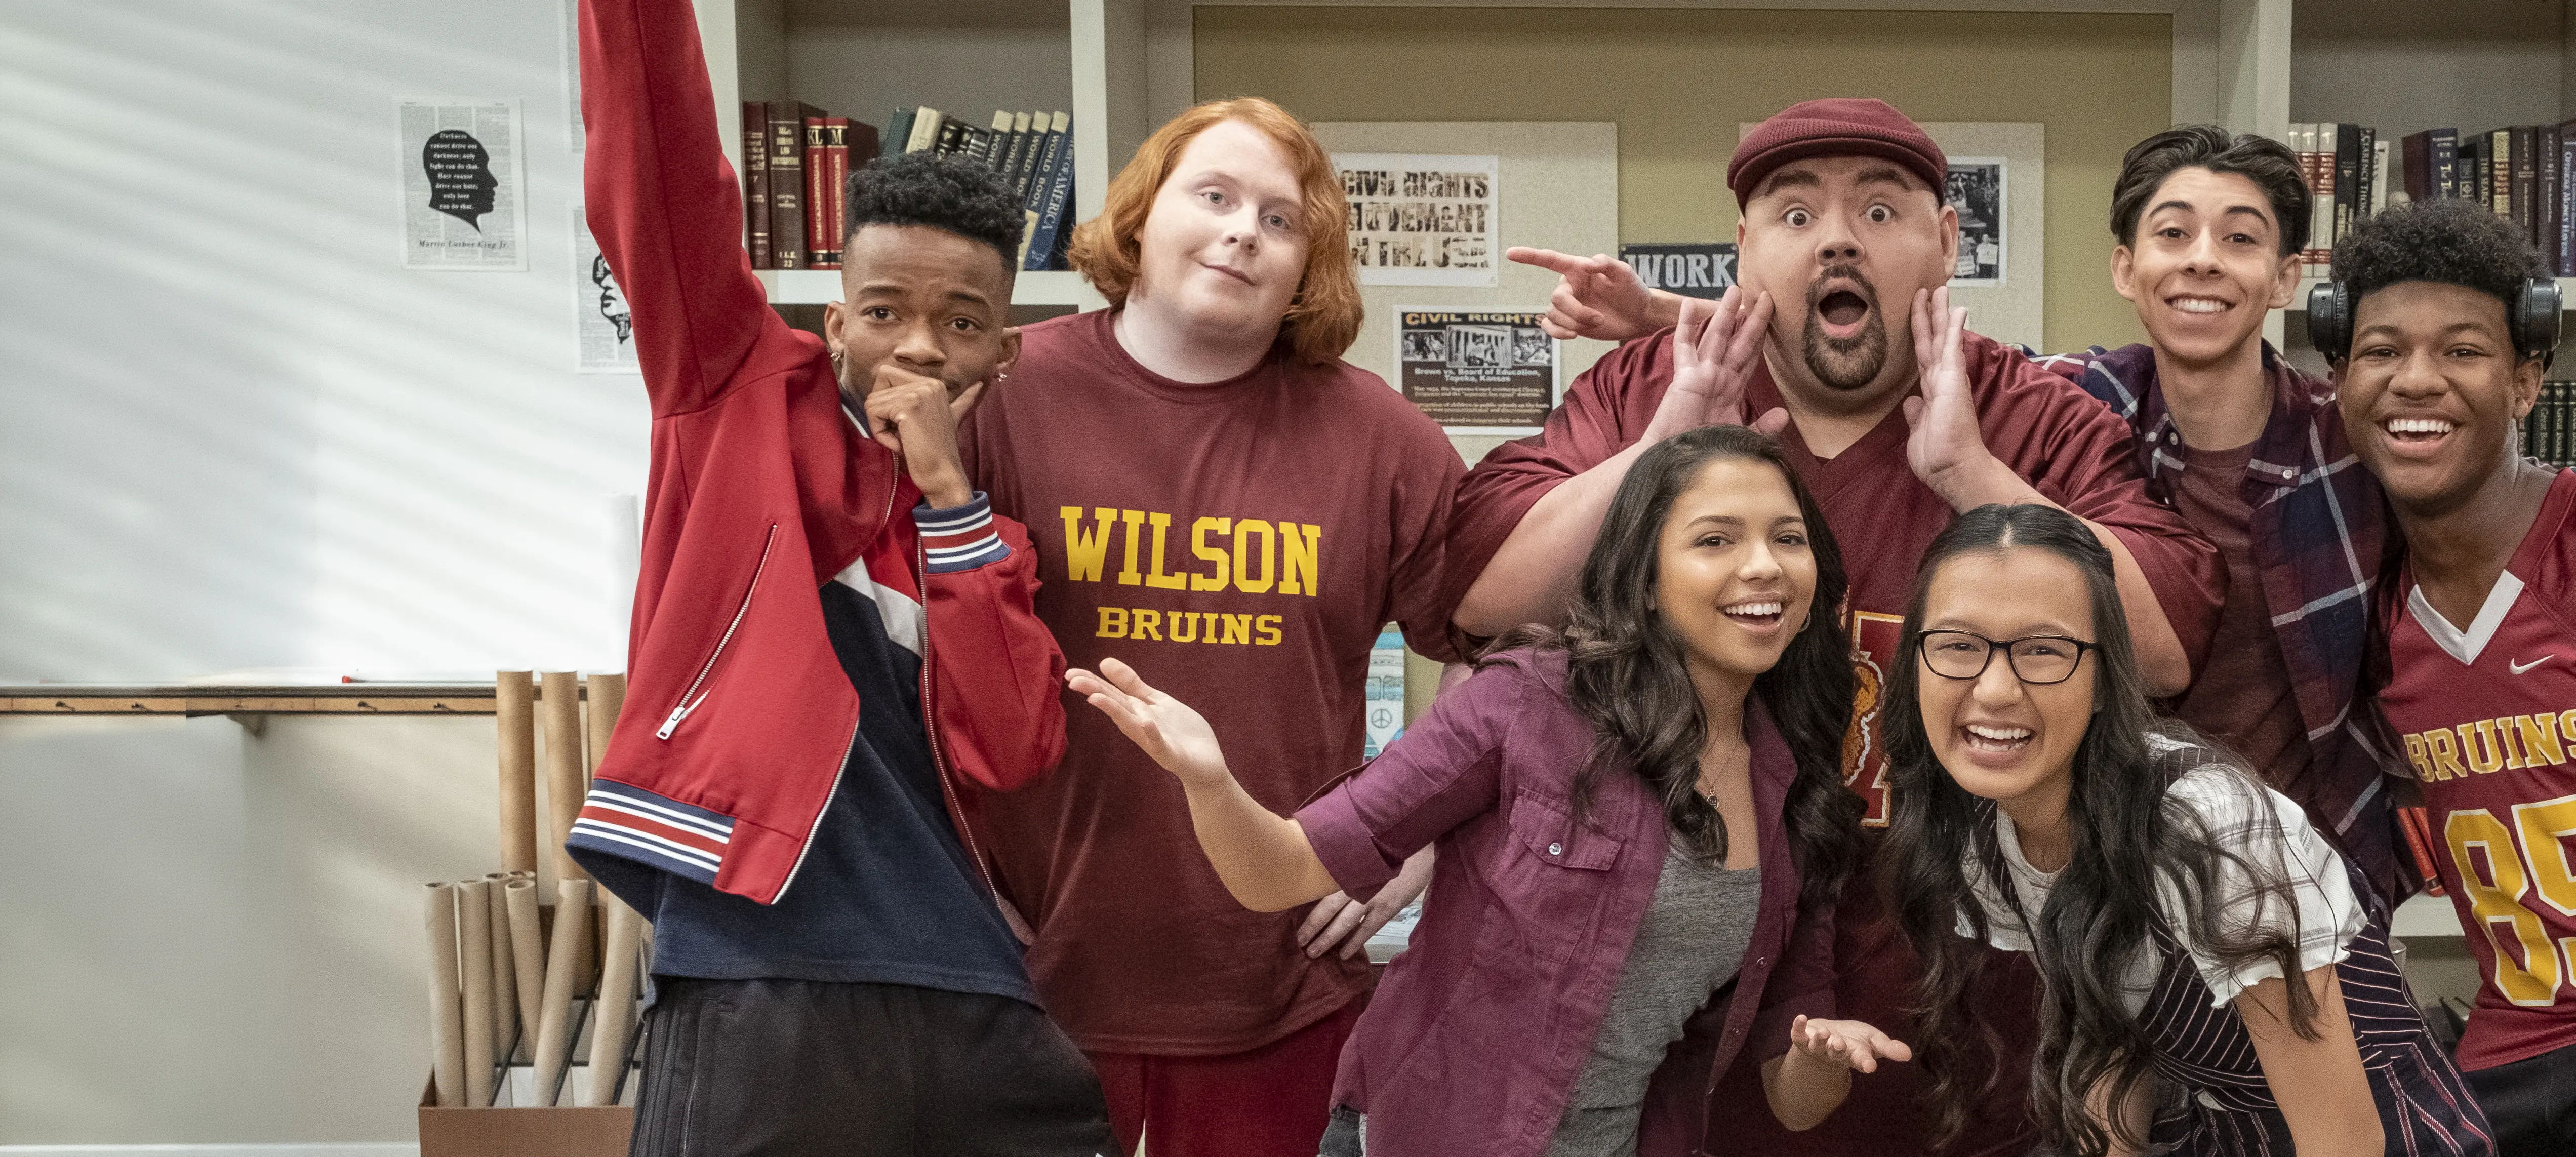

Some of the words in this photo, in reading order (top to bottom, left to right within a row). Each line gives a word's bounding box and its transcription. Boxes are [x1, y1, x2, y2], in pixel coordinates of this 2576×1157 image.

[831, 129, 843, 145] M
[1004, 135, 1021, 172] WORLD
[1023, 135, 1040, 172] WORLD
[1042, 135, 1060, 172] WORLD
[1031, 177, 1046, 207] BOOK
[1342, 170, 1396, 196] CIVIL
[1404, 171, 1489, 198] RIGHTS
[1042, 173, 1068, 230] AMERICA
[477, 241, 496, 249] King
[1376, 237, 1427, 267] THE
[1432, 237, 1489, 268] USA
[1624, 254, 1737, 288] WORK
[1405, 313, 1462, 325] CIVIL
[1458, 368, 1483, 376] Board
[1484, 368, 1493, 376] of
[1060, 506, 1321, 597] WILSON
[1096, 606, 1282, 646] BRUINS
